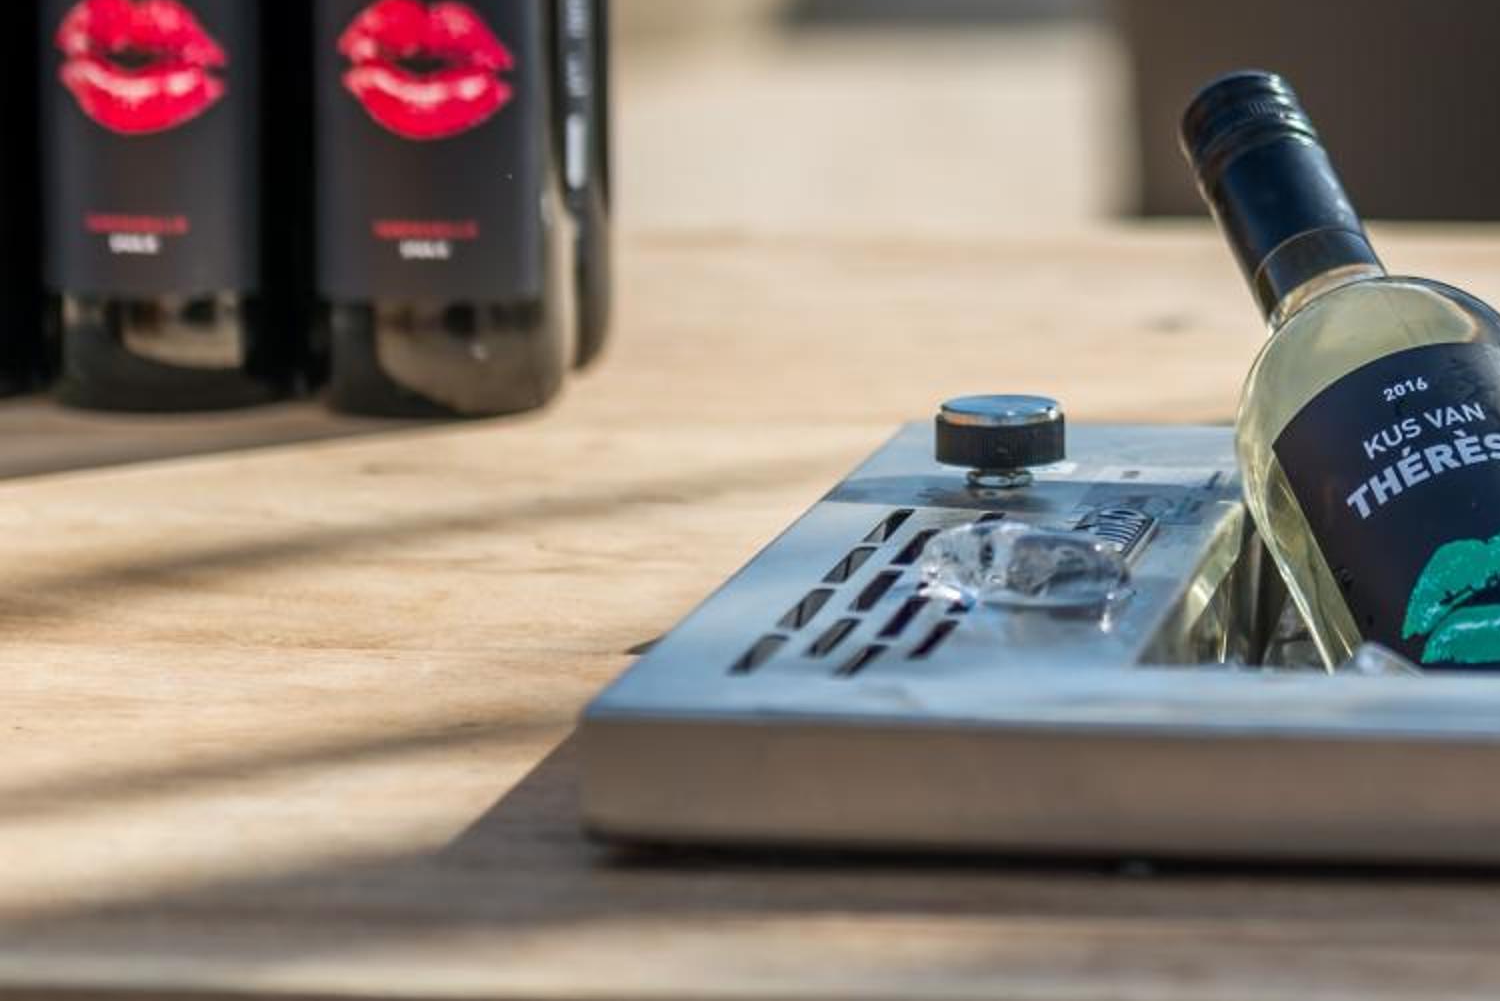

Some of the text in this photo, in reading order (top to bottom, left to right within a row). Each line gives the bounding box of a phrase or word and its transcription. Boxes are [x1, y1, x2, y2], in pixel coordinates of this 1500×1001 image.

[1382, 376, 1430, 403] 2016
[1363, 402, 1486, 459] KUS VAN
